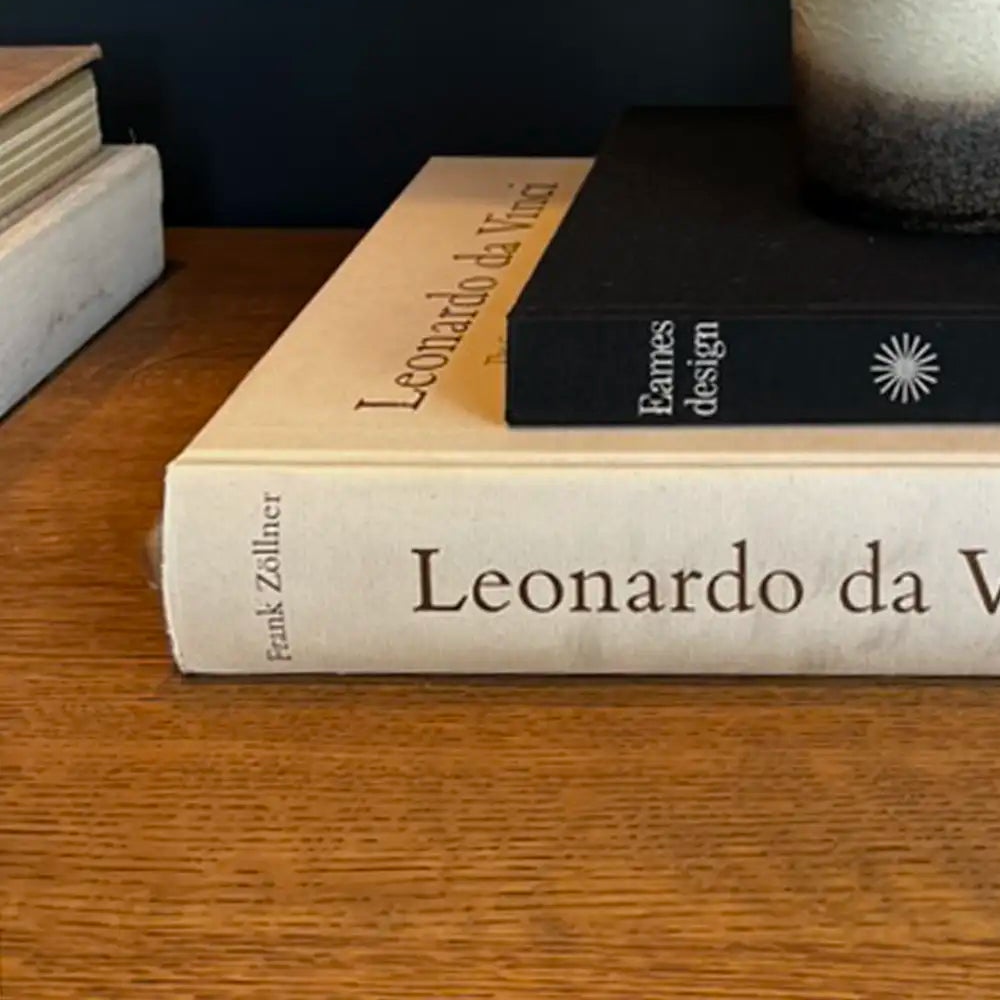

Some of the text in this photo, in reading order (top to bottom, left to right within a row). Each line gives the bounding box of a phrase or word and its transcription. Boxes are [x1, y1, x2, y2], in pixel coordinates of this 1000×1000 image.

[354, 182, 558, 411] Leonardo da Vinci
[638, 320, 675, 416] Eames
[683, 322, 726, 416] design
[251, 492, 292, 662] Frank Zöllner
[411, 540, 805, 617] Leonardo
[840, 540, 930, 617] da
